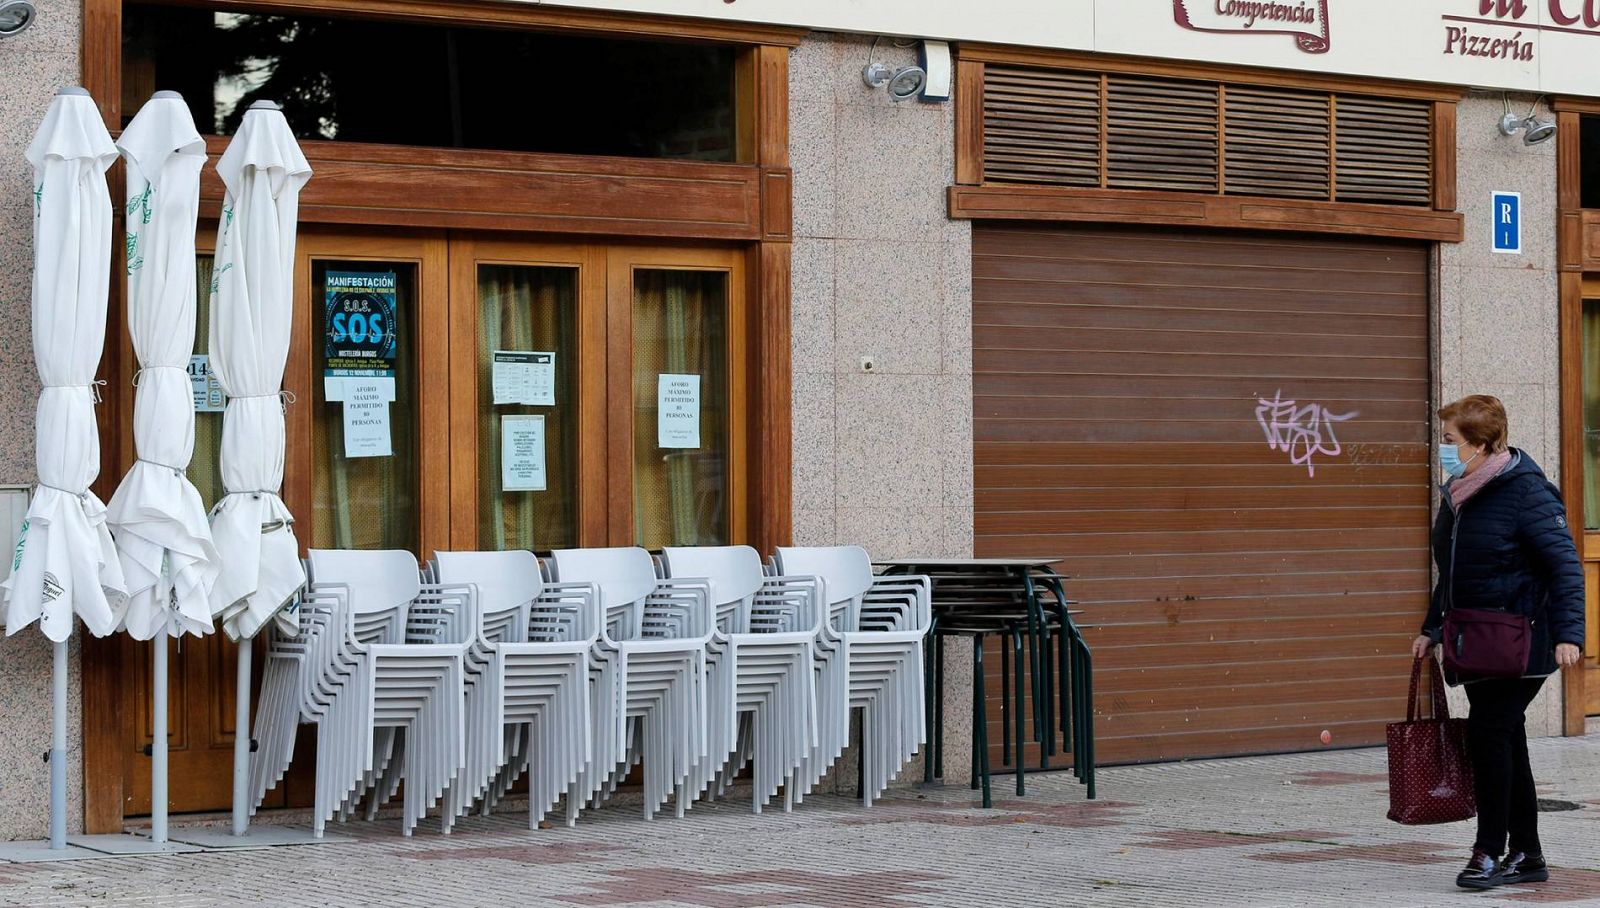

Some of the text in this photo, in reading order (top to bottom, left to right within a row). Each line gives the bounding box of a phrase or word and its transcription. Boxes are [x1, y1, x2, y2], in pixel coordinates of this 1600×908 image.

[1215, 0, 1315, 28] Competencia
[1443, 26, 1534, 61] Pizzería
[1501, 202, 1511, 224] R
[327, 276, 394, 287] MANIFESTACIÓN
[344, 299, 371, 312] S.O.S.
[333, 312, 383, 344] SOS
